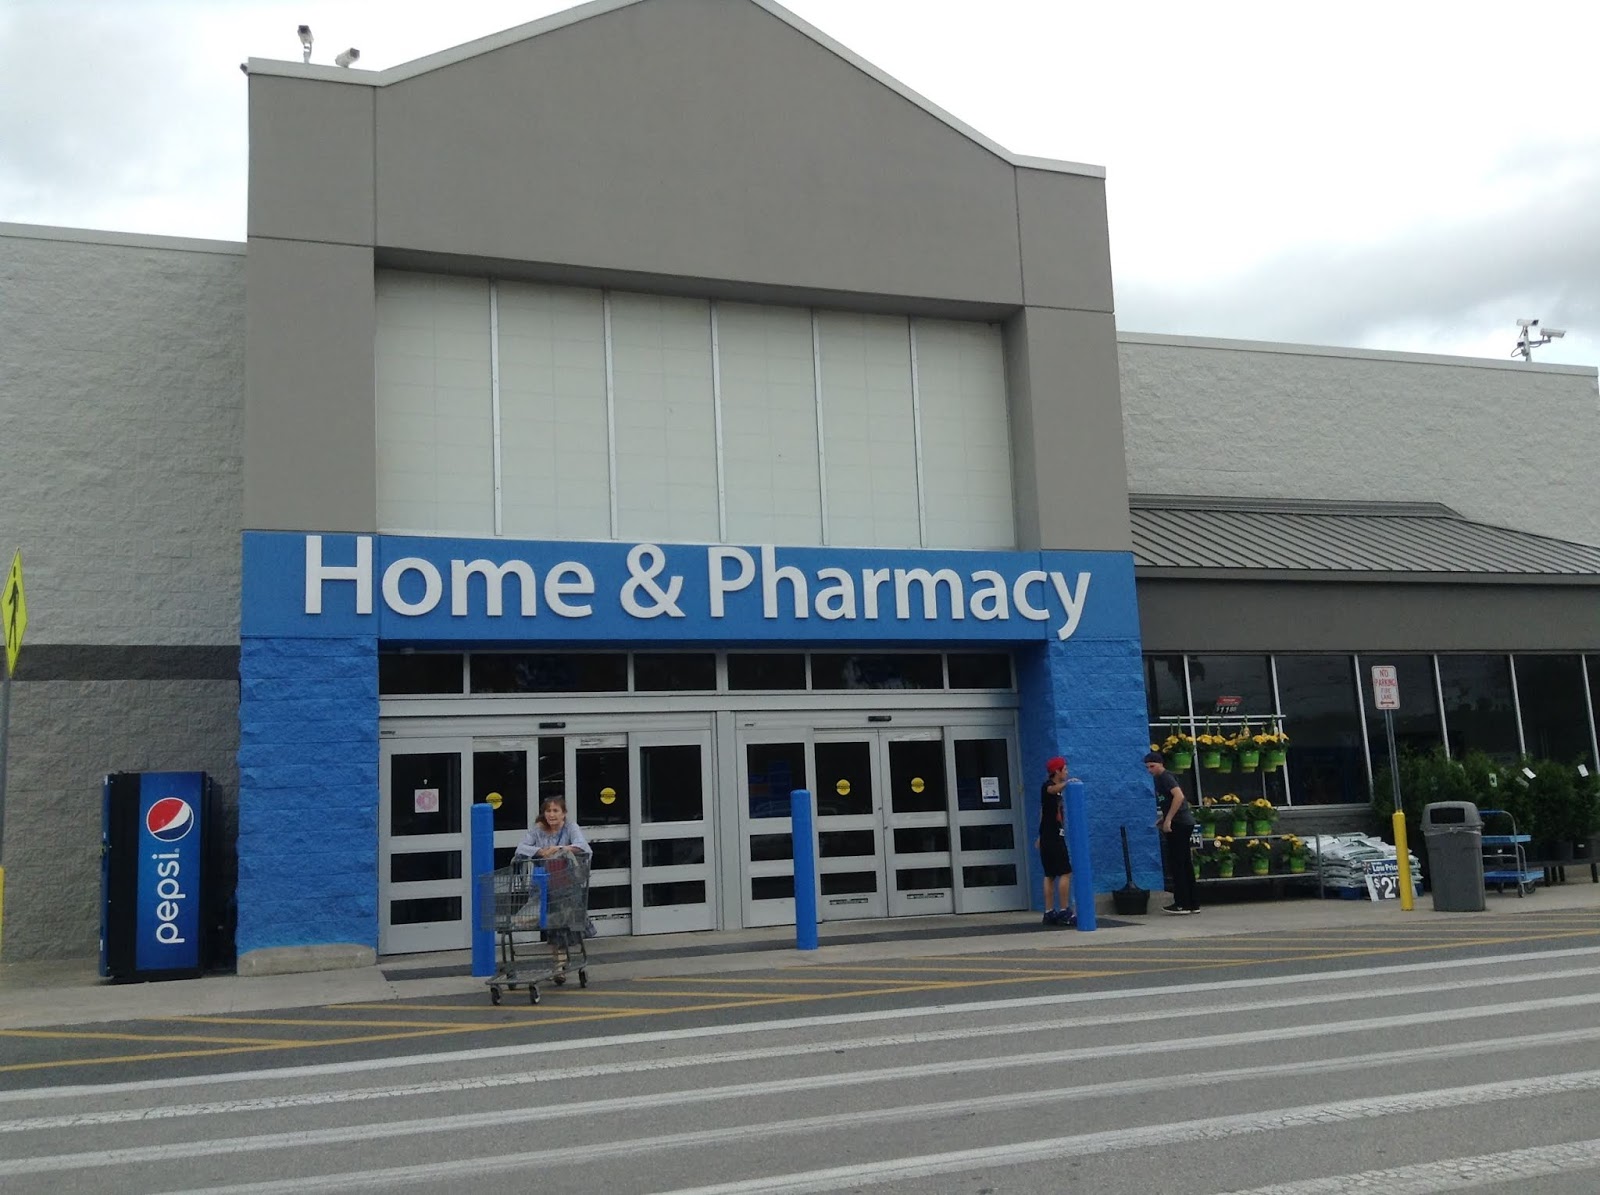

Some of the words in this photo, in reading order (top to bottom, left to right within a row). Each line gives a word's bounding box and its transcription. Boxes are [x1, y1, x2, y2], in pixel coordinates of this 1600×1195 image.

[305, 535, 595, 618] Home
[620, 543, 686, 619] &
[707, 544, 1091, 641] Pharmacy
[1379, 669, 1389, 678] NO
[152, 853, 186, 944] pepsi
